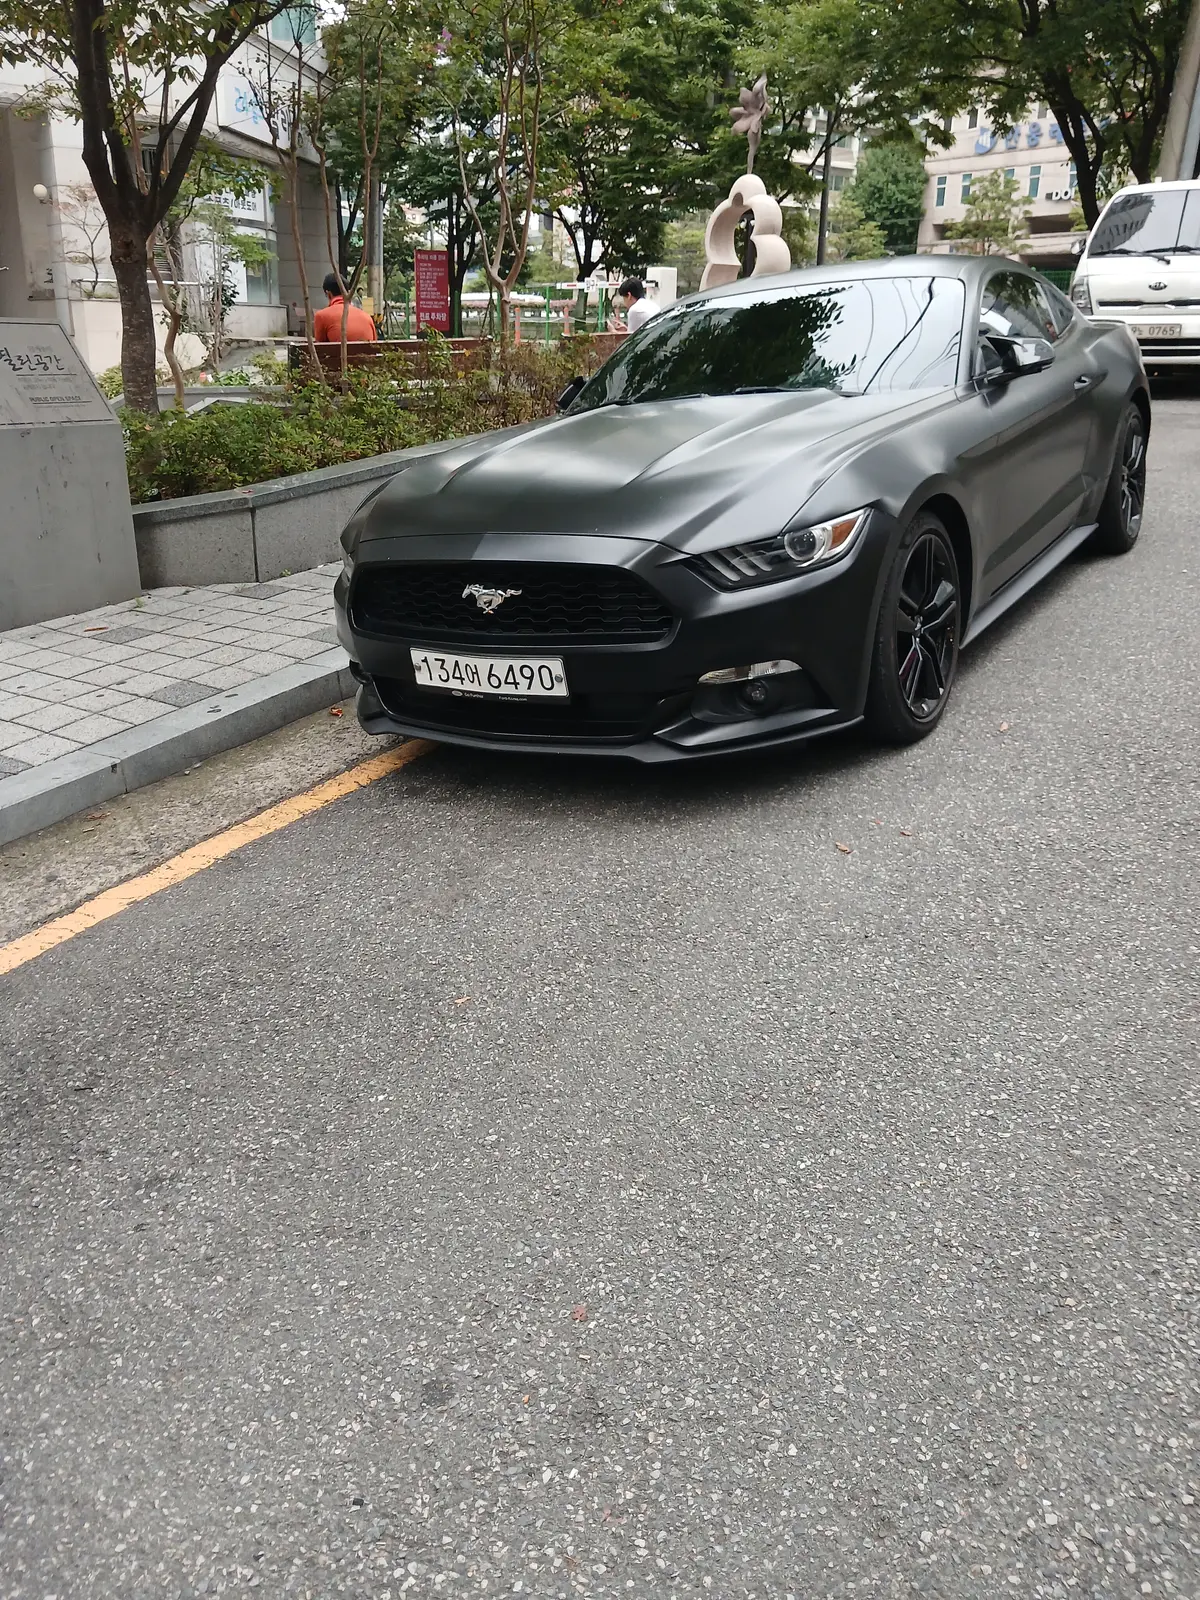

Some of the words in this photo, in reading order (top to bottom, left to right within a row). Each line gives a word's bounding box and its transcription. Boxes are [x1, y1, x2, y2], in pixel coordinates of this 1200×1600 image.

[1148, 326, 1175, 336] 0765
[421, 656, 482, 687] 134어
[487, 663, 555, 692] 6490
